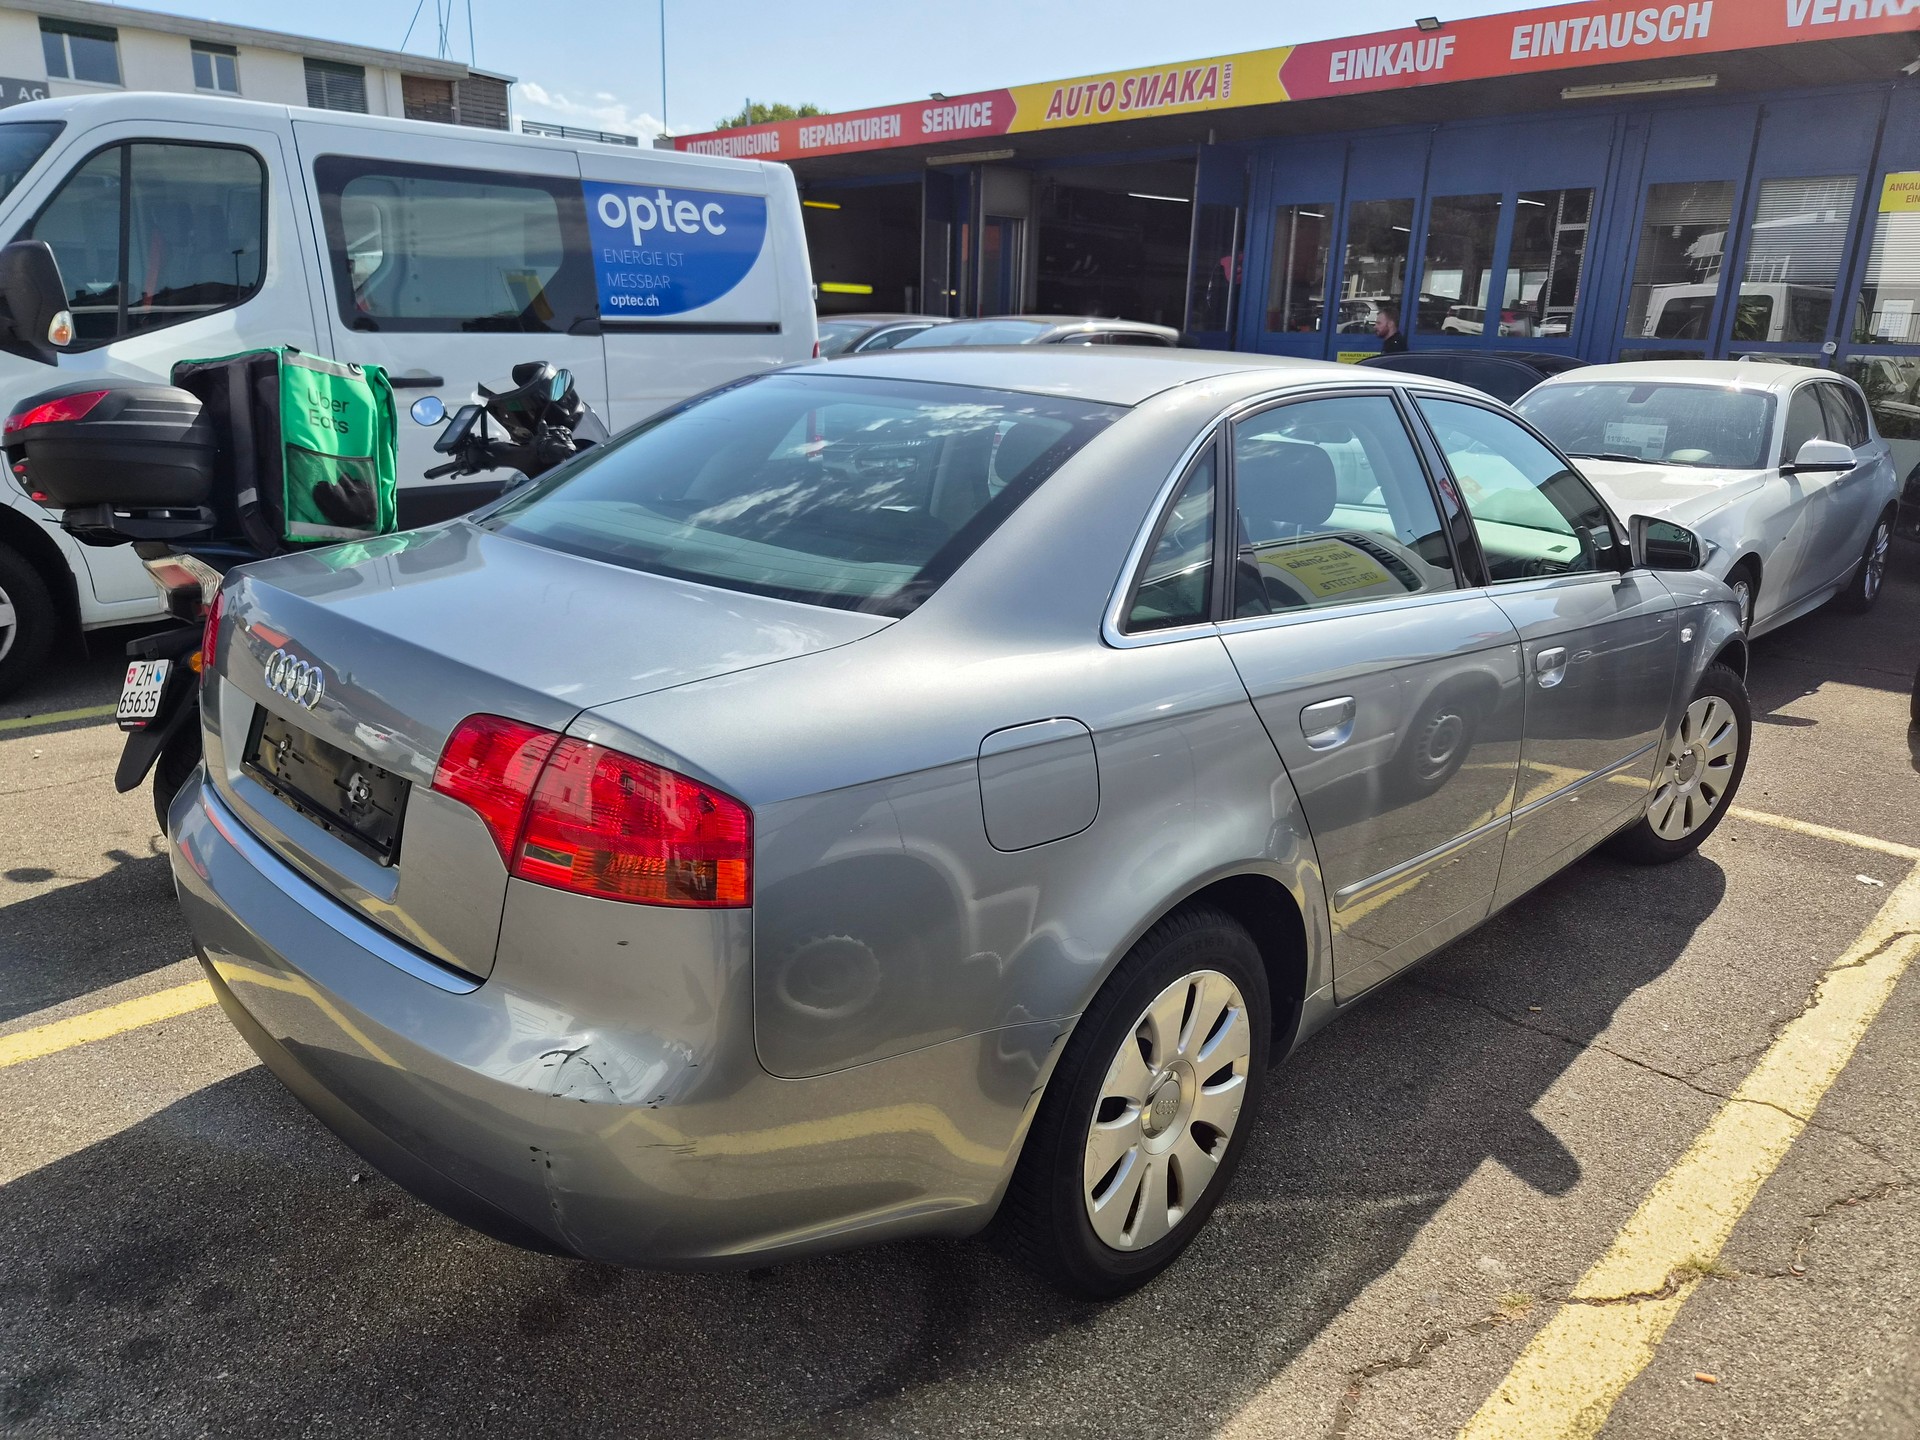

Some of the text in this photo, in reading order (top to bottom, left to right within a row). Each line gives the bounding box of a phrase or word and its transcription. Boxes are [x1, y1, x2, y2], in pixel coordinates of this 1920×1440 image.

[1510, 1, 1714, 60] EINTAUSCH
[1329, 35, 1457, 83] EINKAUF
[18, 87, 45, 101] AG
[1045, 65, 1220, 121] AUTO SMAKA
[1222, 63, 1232, 99] GMBH
[921, 101, 993, 134] SERVICE
[799, 114, 901, 149] REPARATUREN
[598, 189, 727, 246] optec
[604, 248, 684, 268] ENERGIE IST
[607, 272, 671, 289] MESSBAR
[610, 293, 660, 308] optec.ch
[308, 387, 349, 413] Uber
[309, 408, 350, 434] Eats
[136, 664, 155, 687] ZH
[120, 691, 158, 714] 65635
